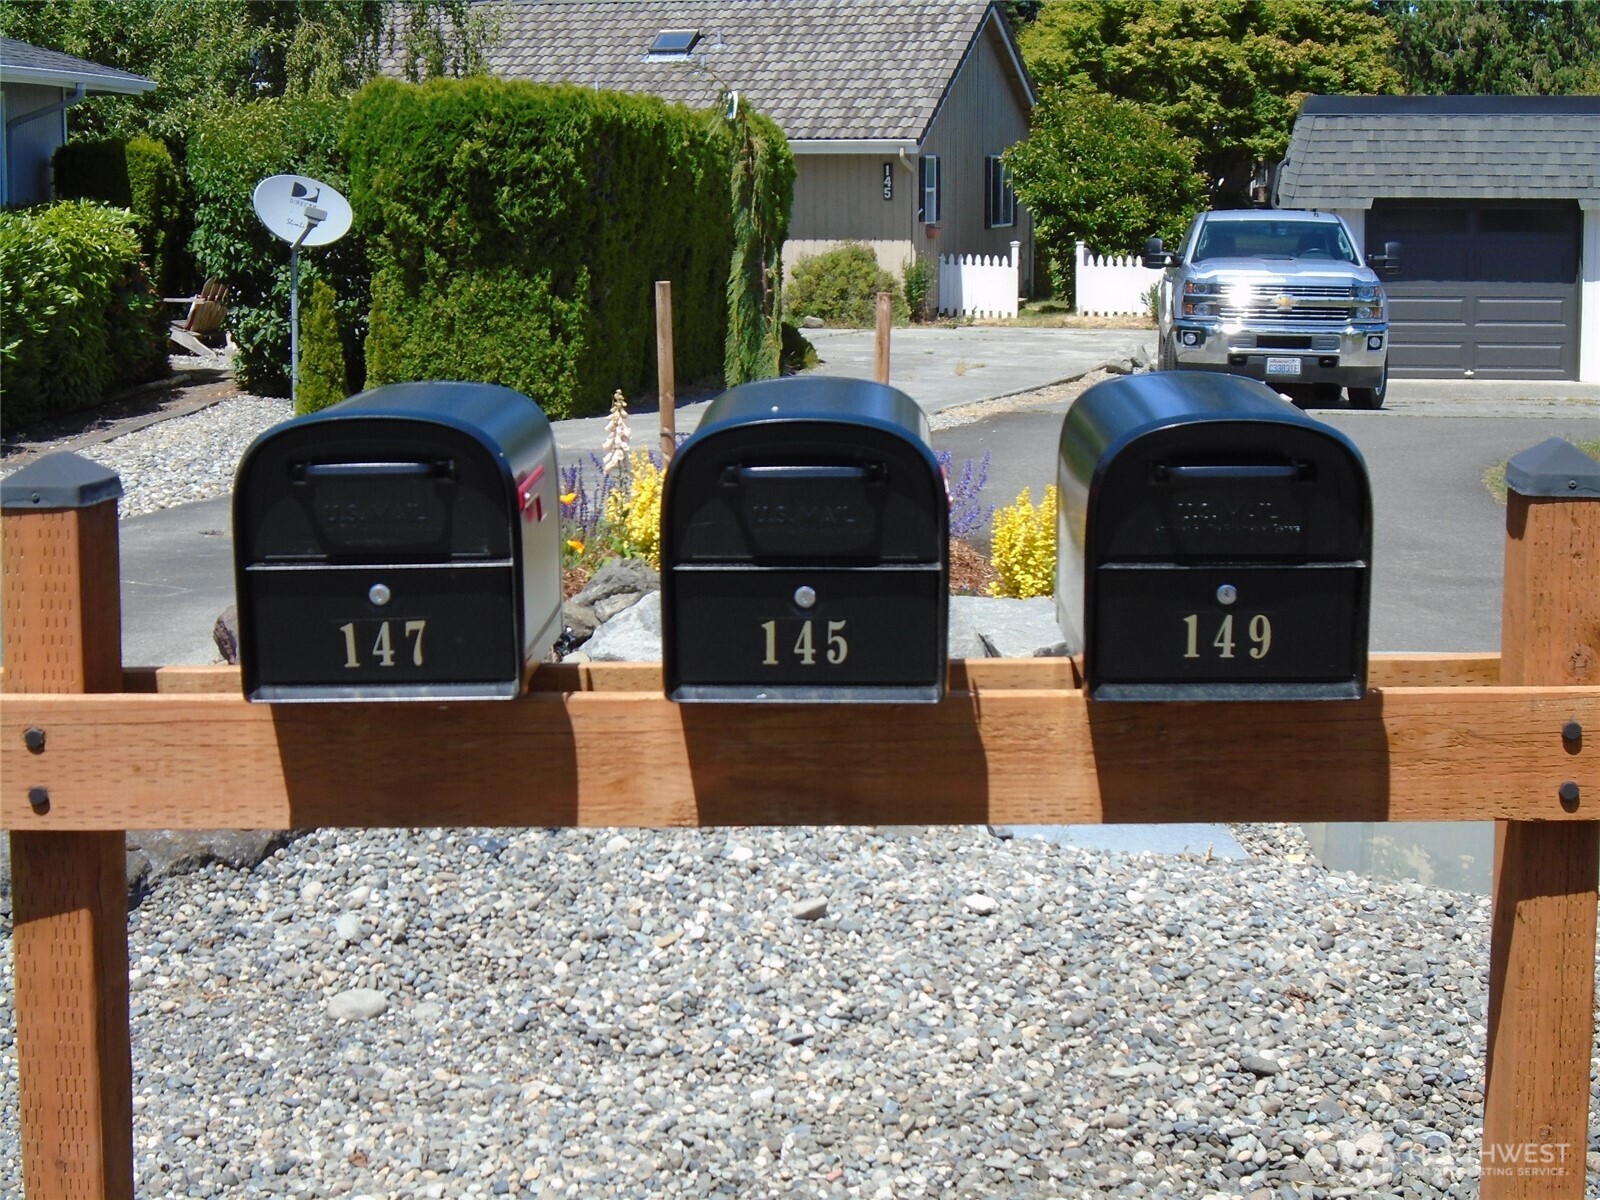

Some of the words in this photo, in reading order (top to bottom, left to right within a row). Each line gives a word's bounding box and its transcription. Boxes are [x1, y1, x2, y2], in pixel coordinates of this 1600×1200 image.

[340, 620, 426, 668] 147
[761, 619, 848, 665] 145
[1183, 614, 1272, 659] 149
